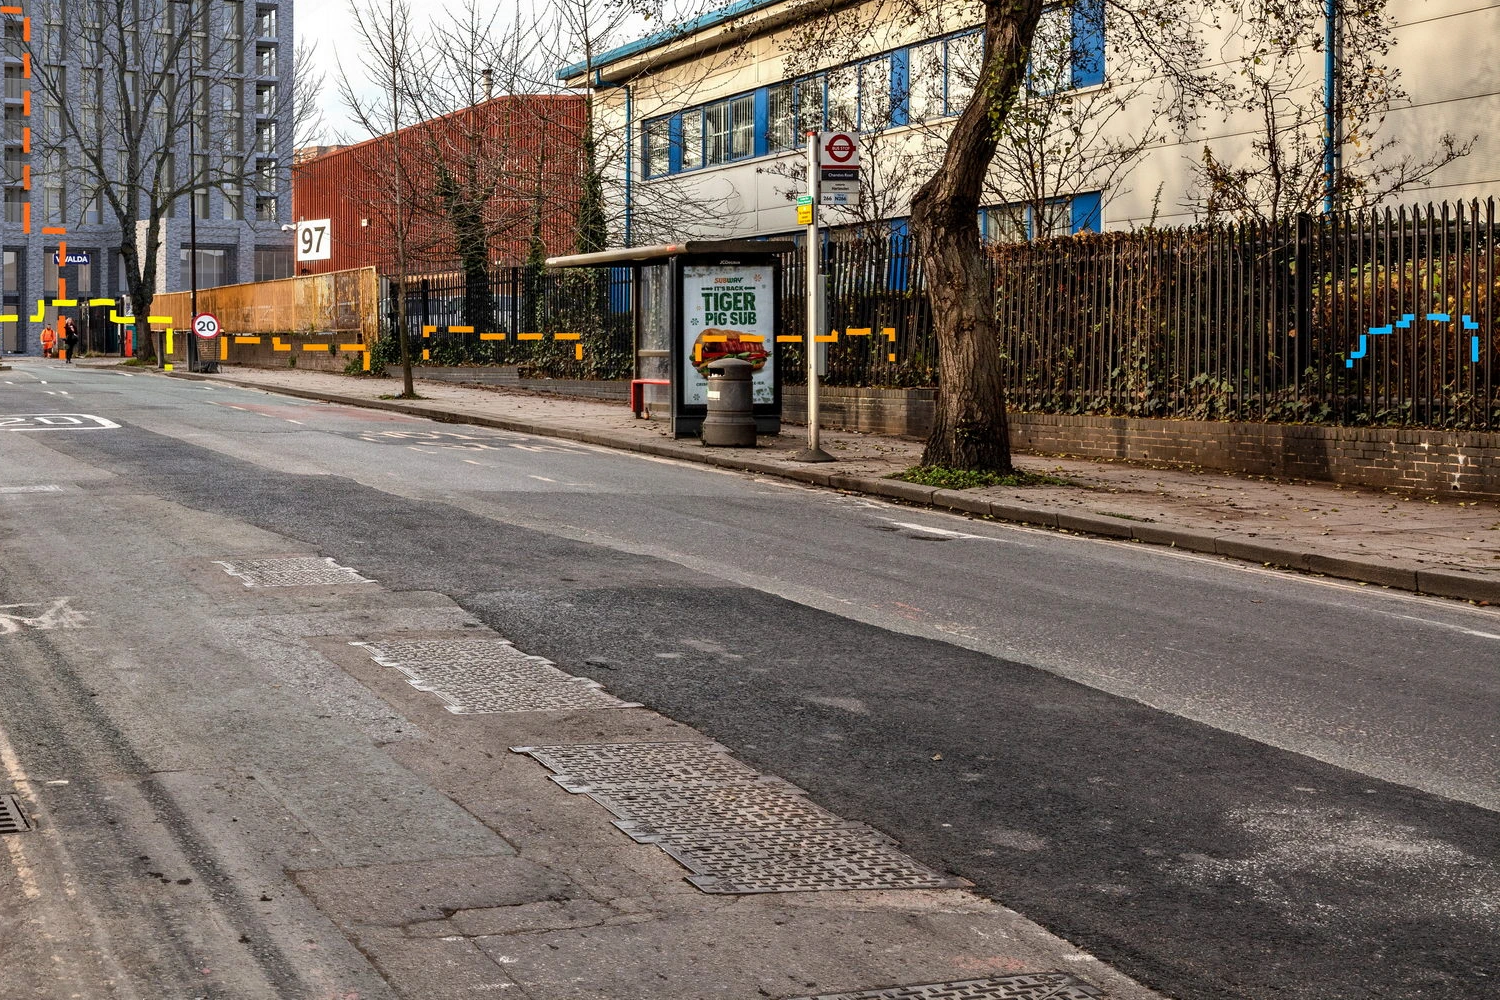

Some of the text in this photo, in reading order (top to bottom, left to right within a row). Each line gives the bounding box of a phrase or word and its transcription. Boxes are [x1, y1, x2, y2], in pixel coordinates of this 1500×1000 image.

[301, 226, 326, 254] 97
[55, 255, 88, 263] VVALDA
[701, 292, 756, 312] TIGER
[196, 320, 216, 332] 20
[704, 311, 757, 326] PIG SUB
